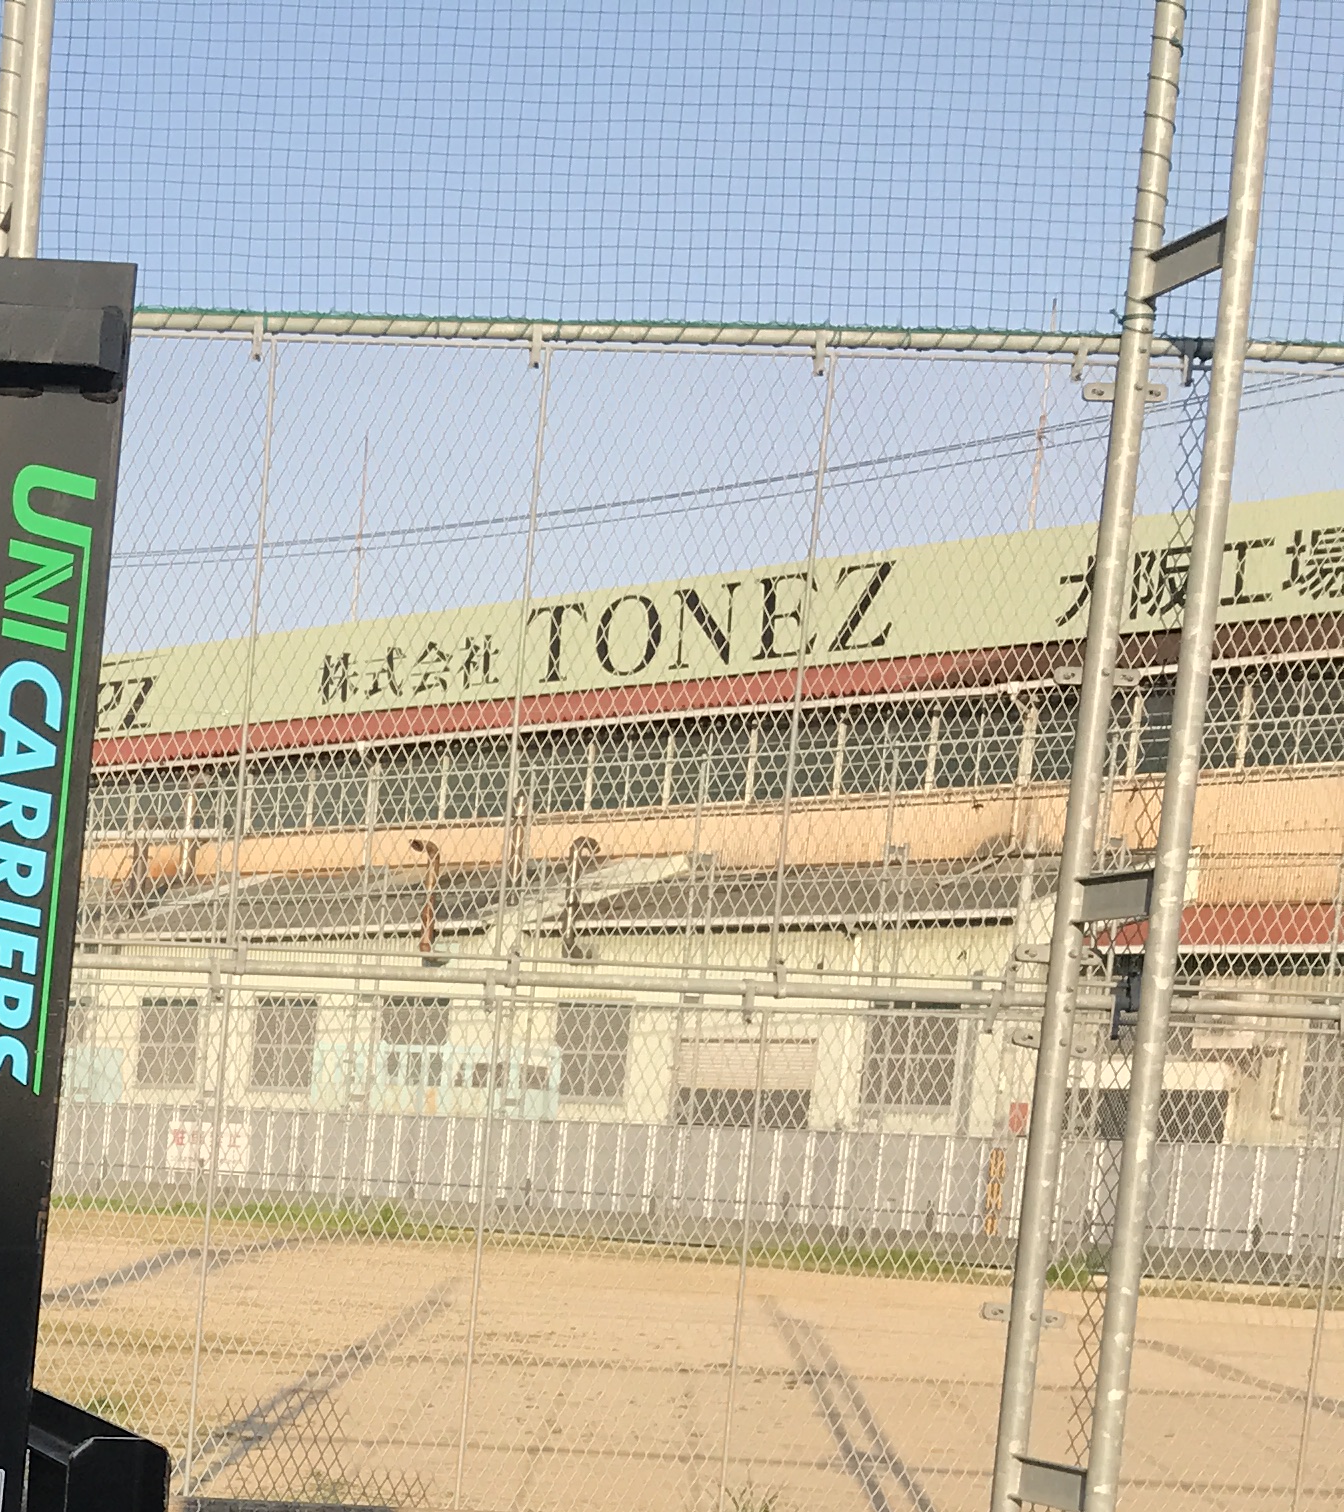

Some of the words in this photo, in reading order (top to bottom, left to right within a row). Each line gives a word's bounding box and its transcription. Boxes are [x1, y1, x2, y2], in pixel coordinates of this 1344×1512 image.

[318, 633, 500, 706] 株式会社
[528, 559, 897, 685] TONEZ
[172, 1128, 242, 1149] 駐車止
